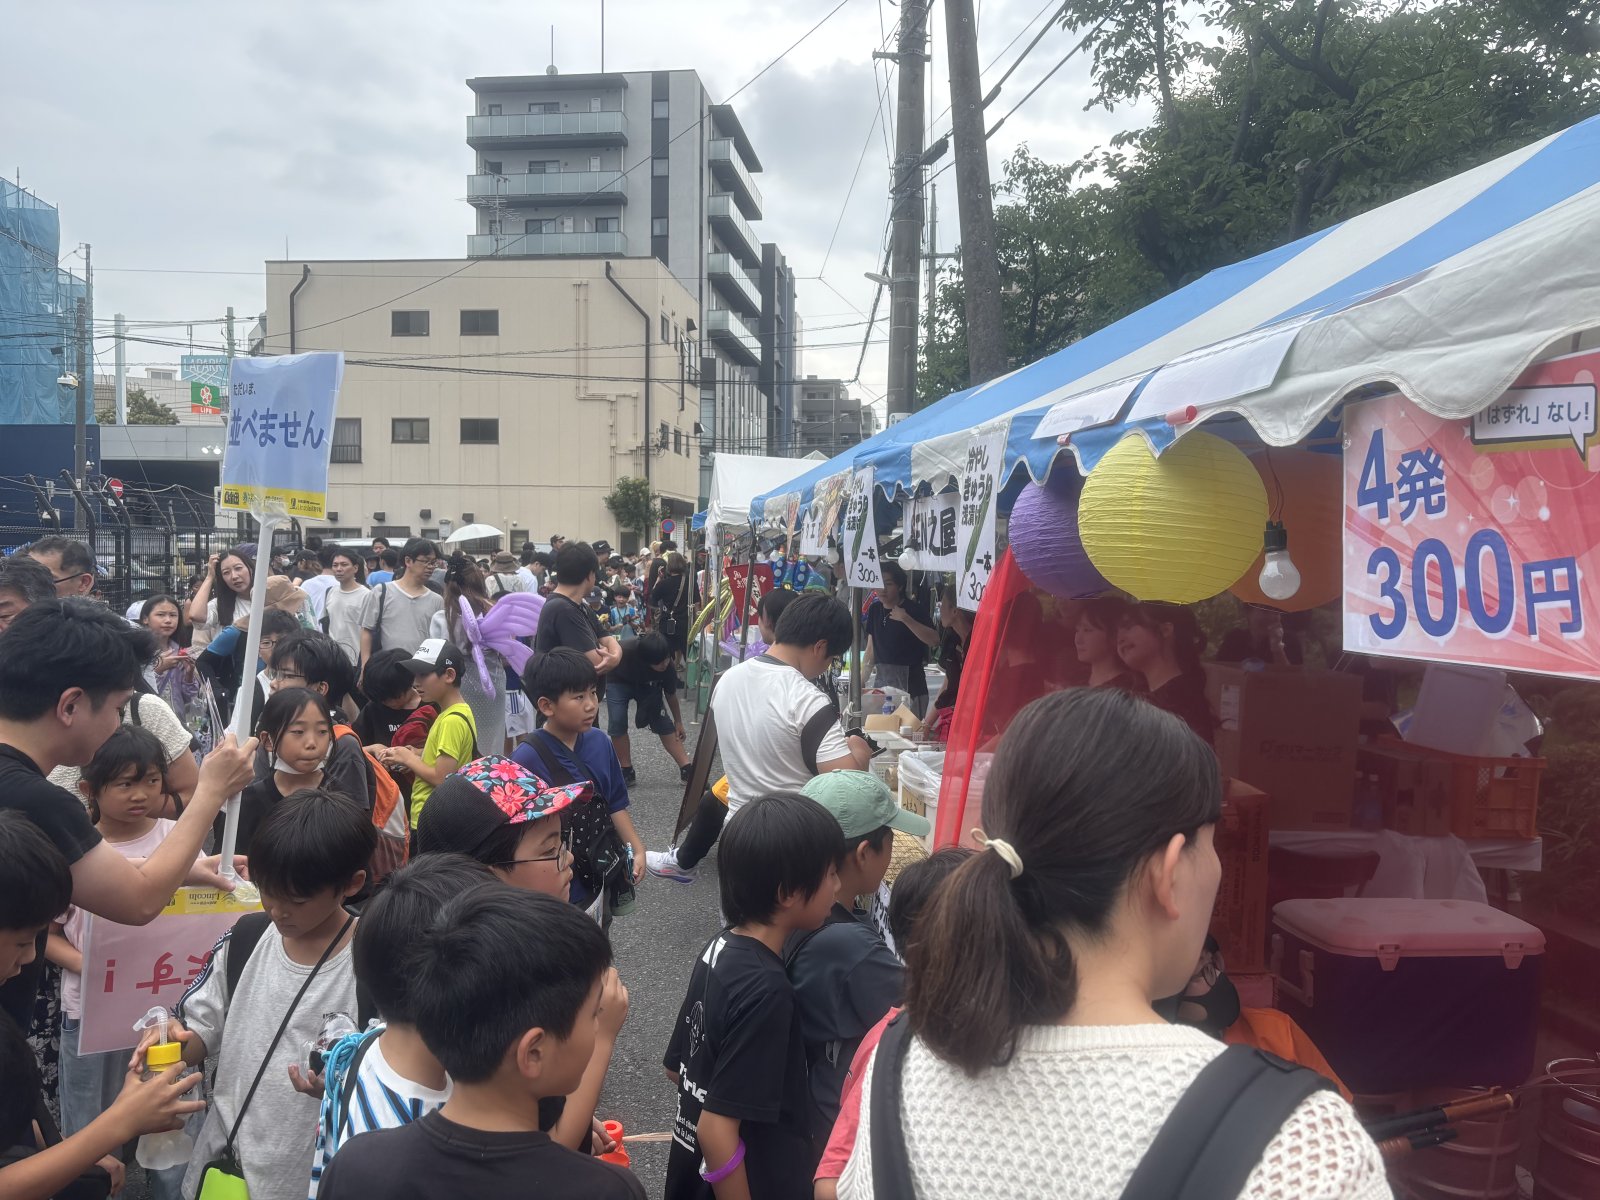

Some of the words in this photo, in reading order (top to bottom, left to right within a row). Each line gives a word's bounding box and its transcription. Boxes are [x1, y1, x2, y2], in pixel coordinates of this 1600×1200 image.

[183, 357, 224, 372] LAPARK
[228, 407, 325, 450] 並べません
[966, 445, 989, 474] 冷やし
[963, 472, 993, 502] きゅうり
[1356, 427, 1447, 523] 4発
[1366, 527, 1583, 641] 300円
[189, 892, 220, 901] Lincoln
